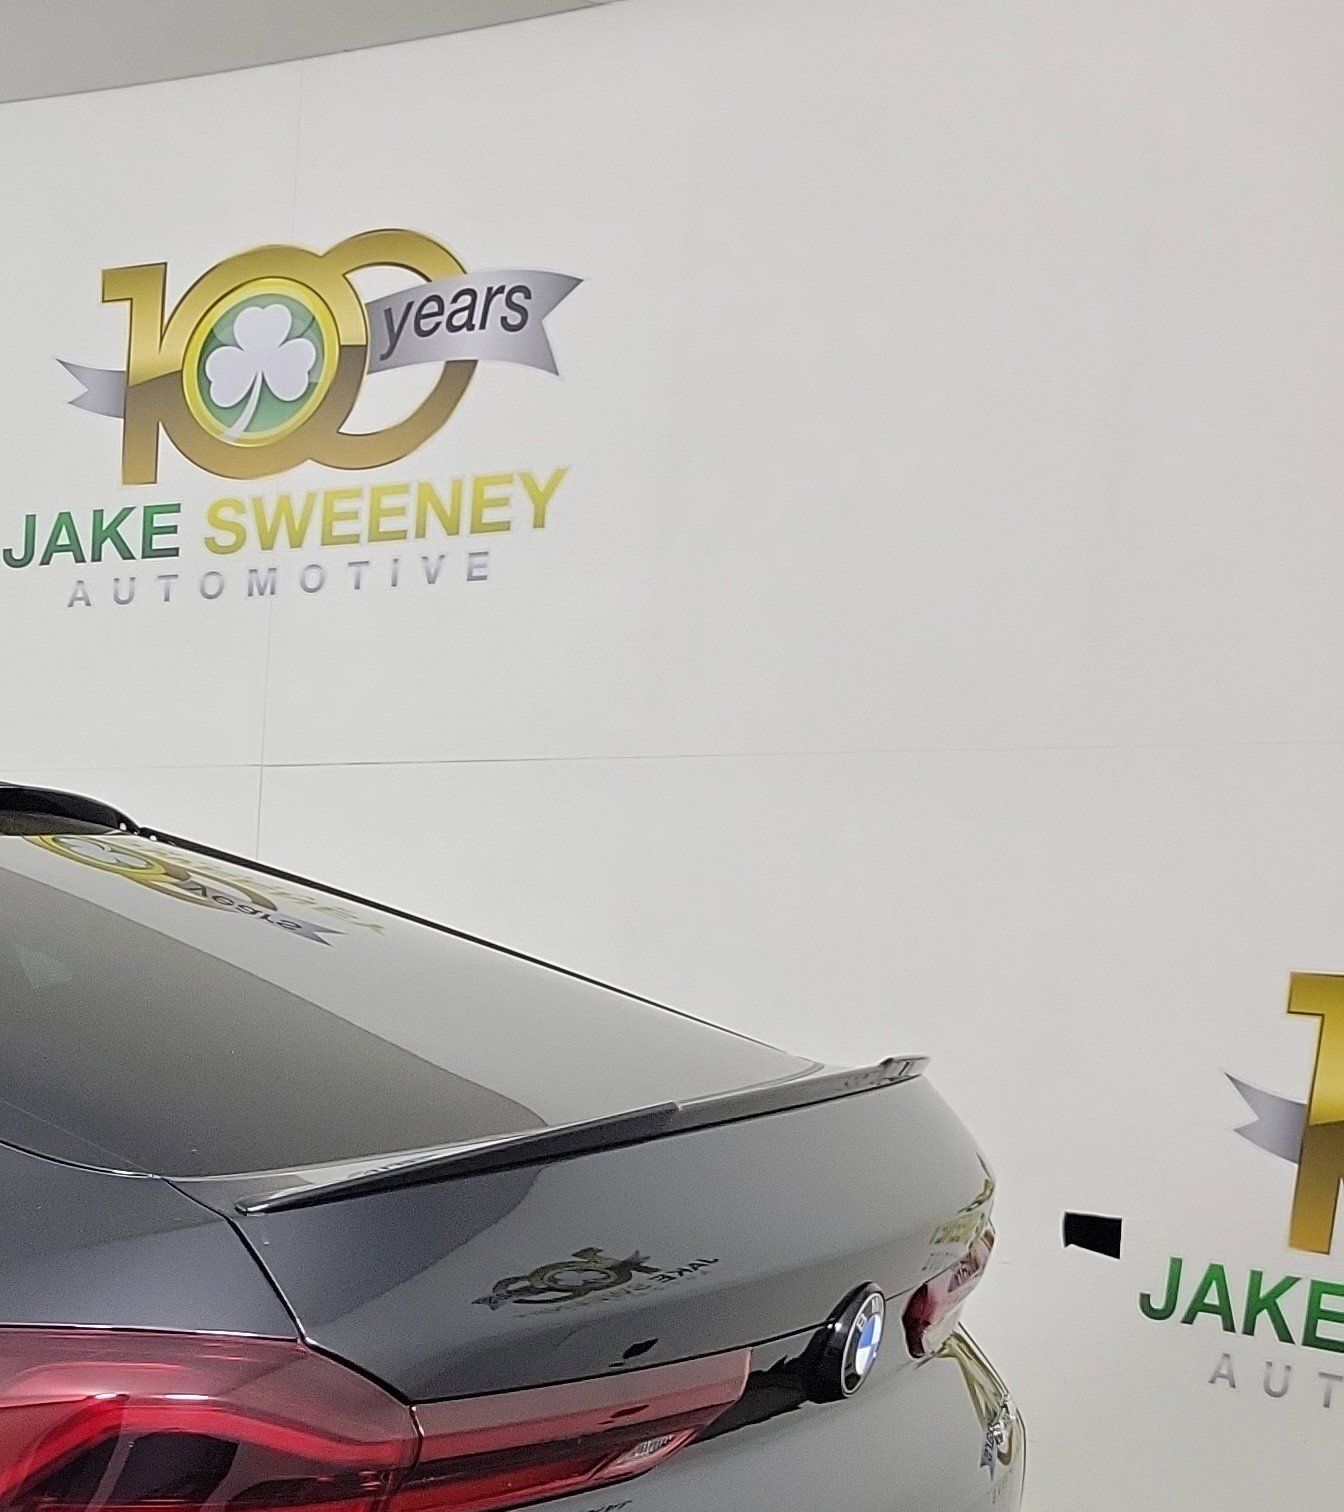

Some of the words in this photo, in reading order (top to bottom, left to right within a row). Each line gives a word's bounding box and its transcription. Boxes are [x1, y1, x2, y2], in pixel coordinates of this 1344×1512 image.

[101, 227, 479, 486] 100
[380, 282, 533, 362] years
[2, 502, 182, 569] JAKE
[203, 467, 570, 556] SWEENEY
[67, 551, 492, 609] AUTOMOTIVE
[1139, 1256, 1344, 1354] JAKE
